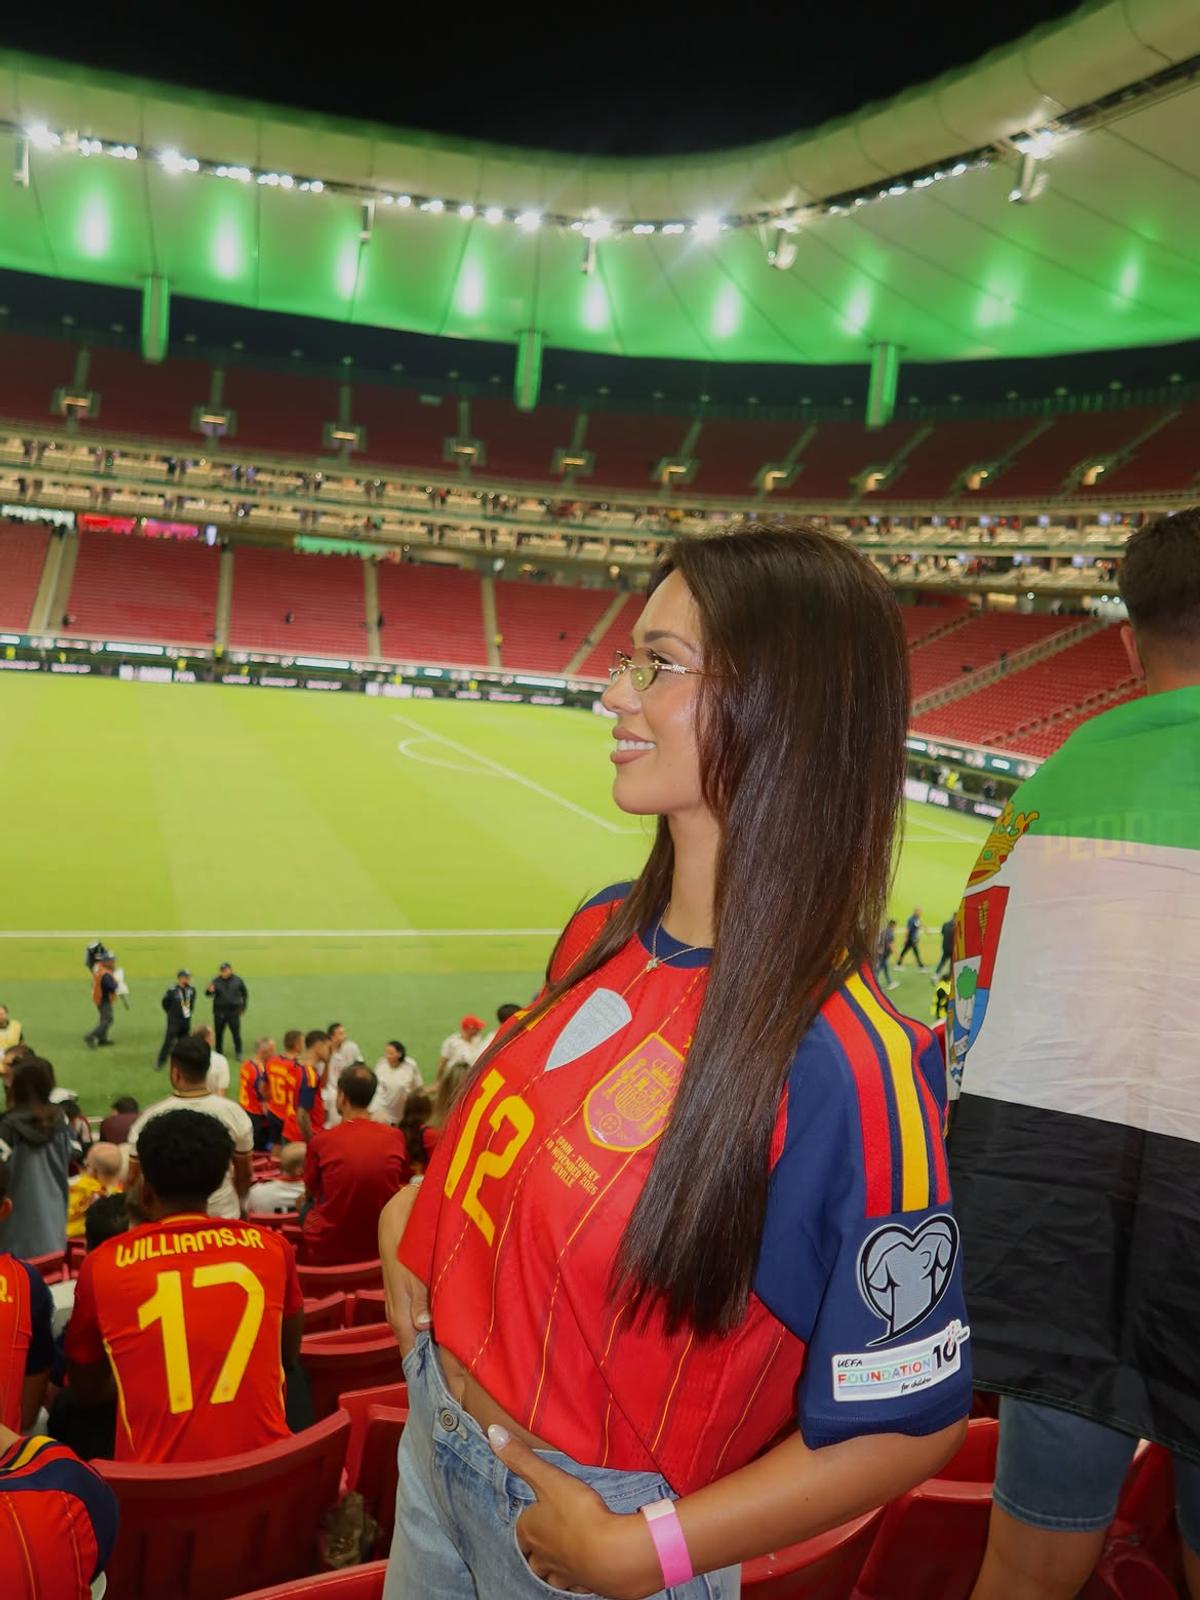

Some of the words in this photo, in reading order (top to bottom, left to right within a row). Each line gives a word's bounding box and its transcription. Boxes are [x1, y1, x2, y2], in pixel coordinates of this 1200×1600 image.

[444, 1068, 536, 1247] 12
[137, 1261, 265, 1415] 17
[837, 1359, 863, 1368] UEFA
[837, 1357, 931, 1384] FOUNDATION
